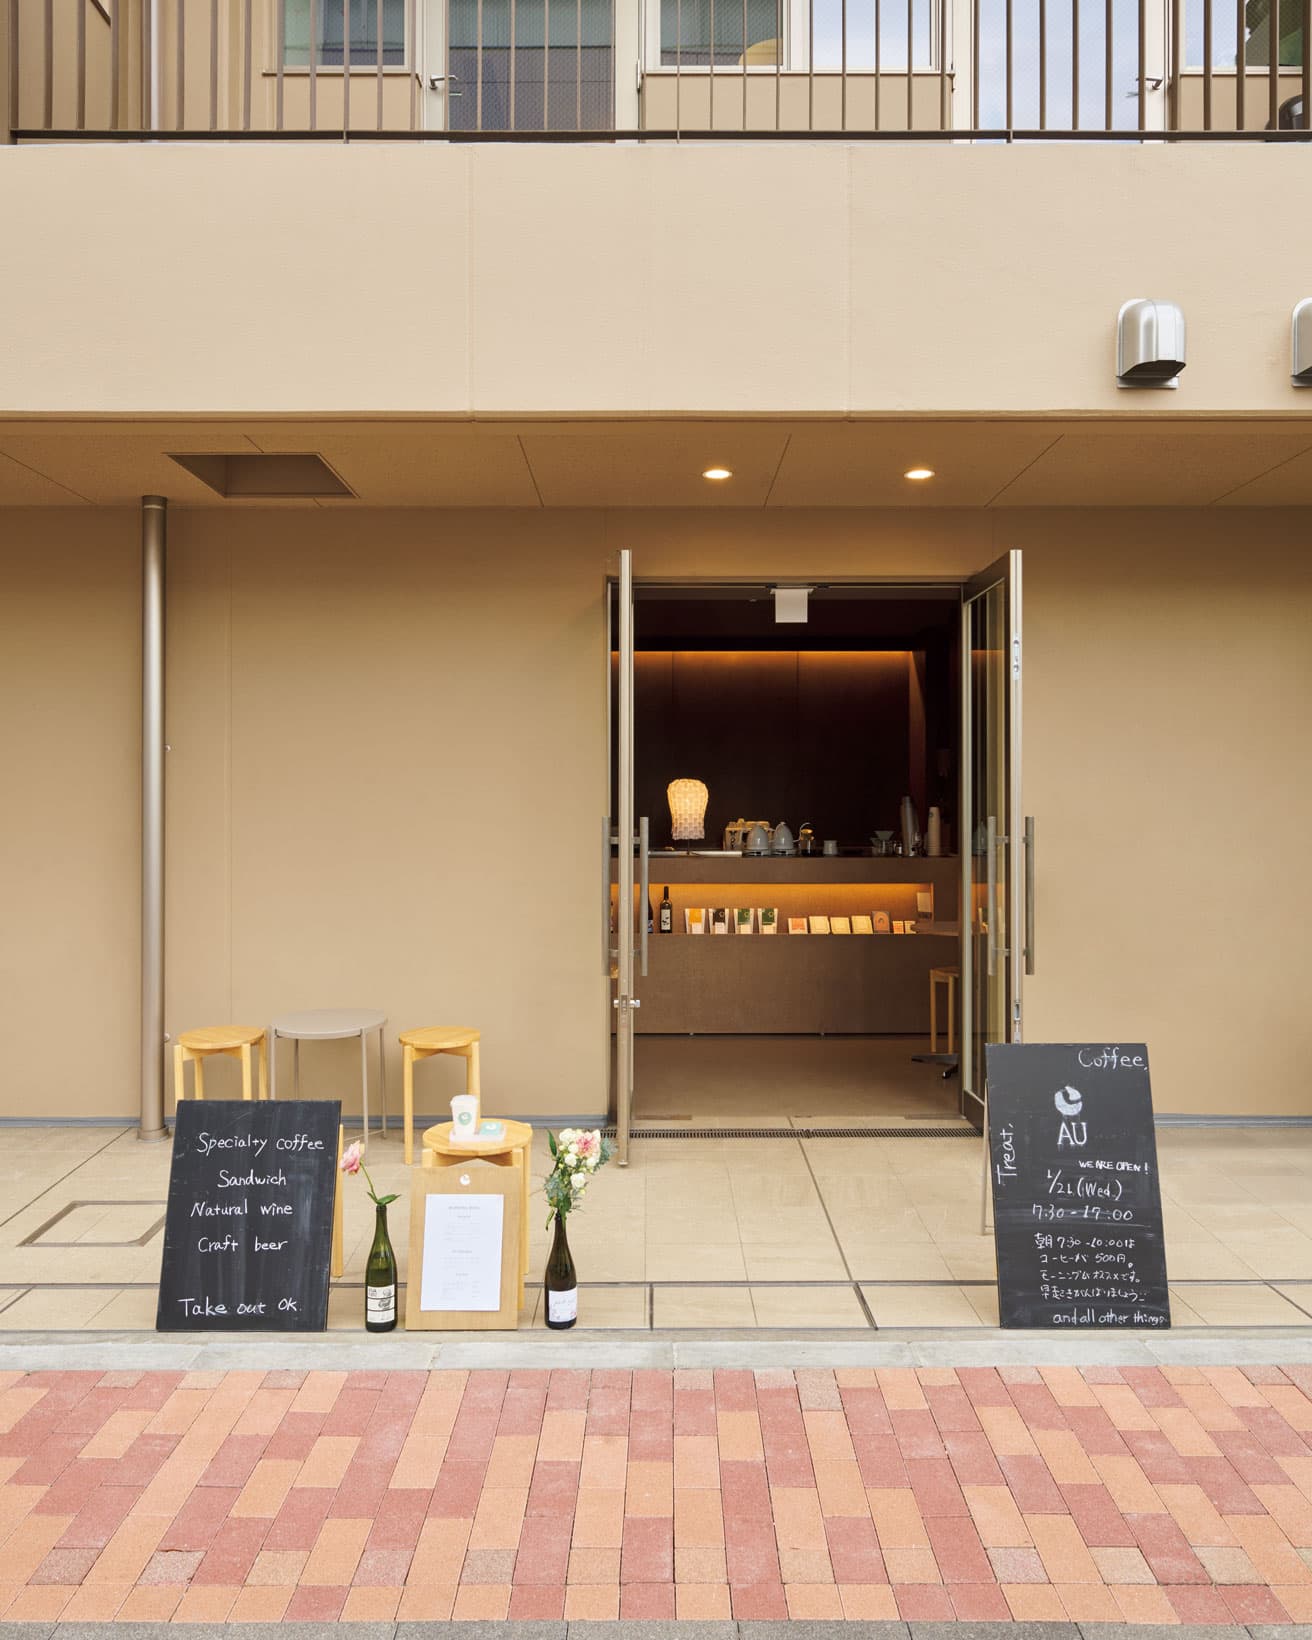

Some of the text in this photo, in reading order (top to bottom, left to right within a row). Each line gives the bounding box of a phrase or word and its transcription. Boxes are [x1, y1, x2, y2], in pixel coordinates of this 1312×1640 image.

[1057, 1121, 1088, 1145] AU
[197, 1132, 325, 1157] Specialty coffee
[1078, 1160, 1094, 1169] WE
[217, 1168, 287, 1188] Sandwich
[190, 1199, 293, 1217] Natural wine
[198, 1234, 288, 1253] Craft beer
[178, 1296, 227, 1318] Take
[237, 1303, 266, 1315] out
[1053, 1308, 1077, 1325] and
[1080, 1308, 1095, 1323] all
[1099, 1308, 1128, 1324] other
